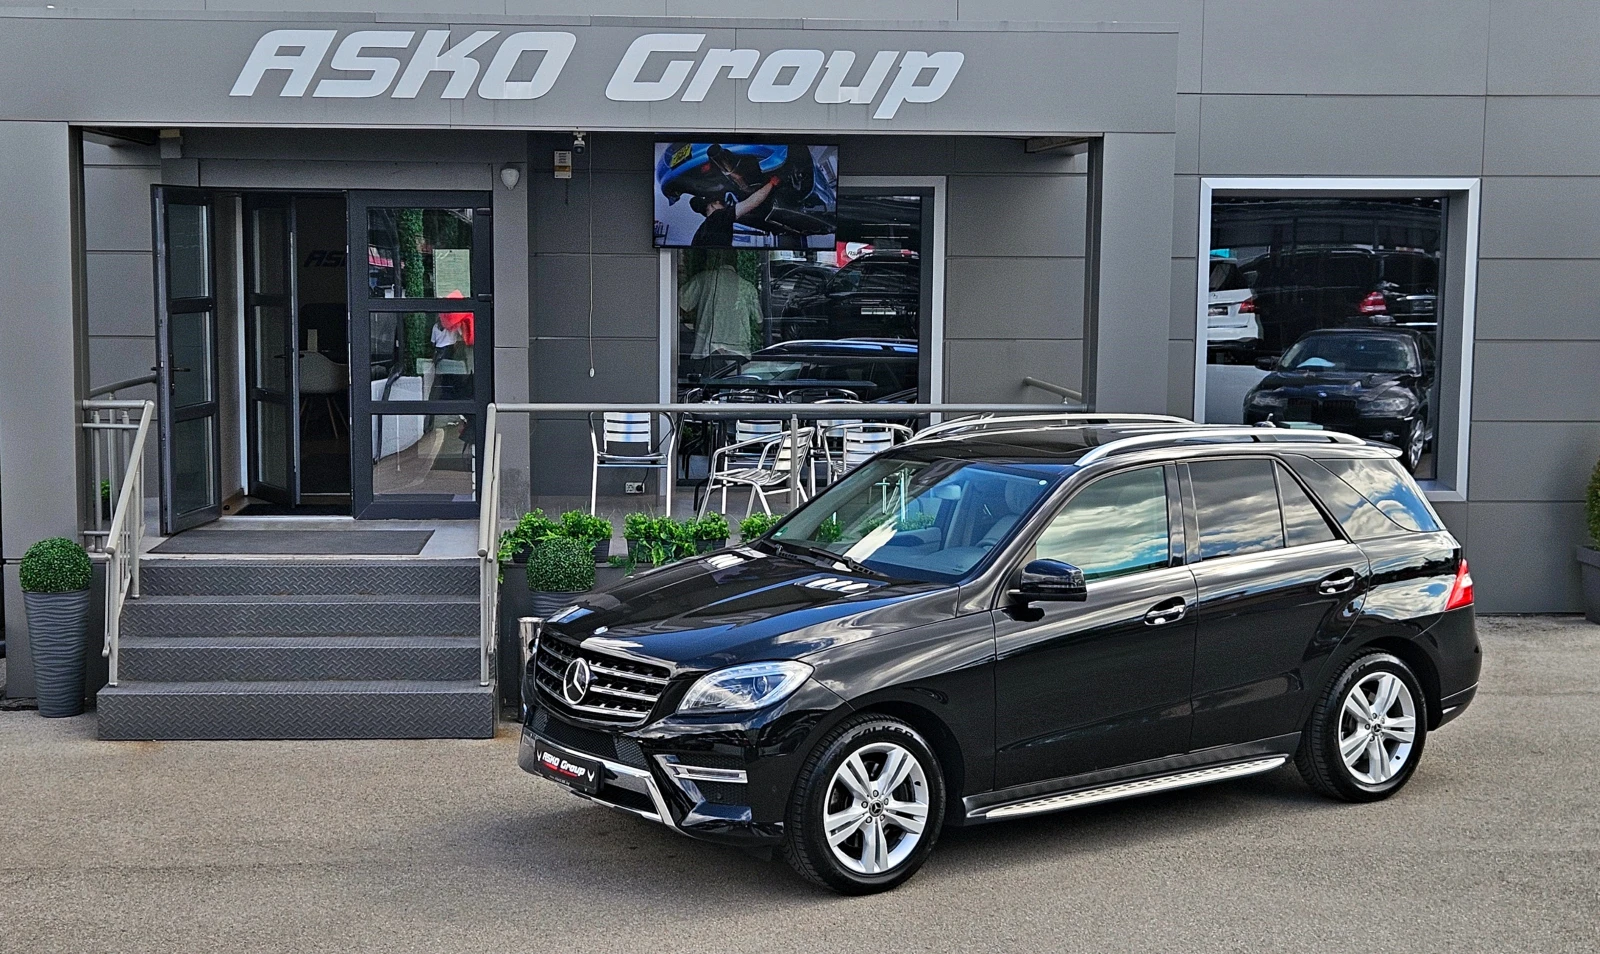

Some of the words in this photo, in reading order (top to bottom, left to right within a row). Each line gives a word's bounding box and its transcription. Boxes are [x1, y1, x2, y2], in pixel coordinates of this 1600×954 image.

[229, 29, 577, 100] ASKO
[605, 33, 965, 119] Group
[303, 250, 347, 267] AS
[542, 751, 560, 767] ASKO
[560, 760, 586, 777] Group
